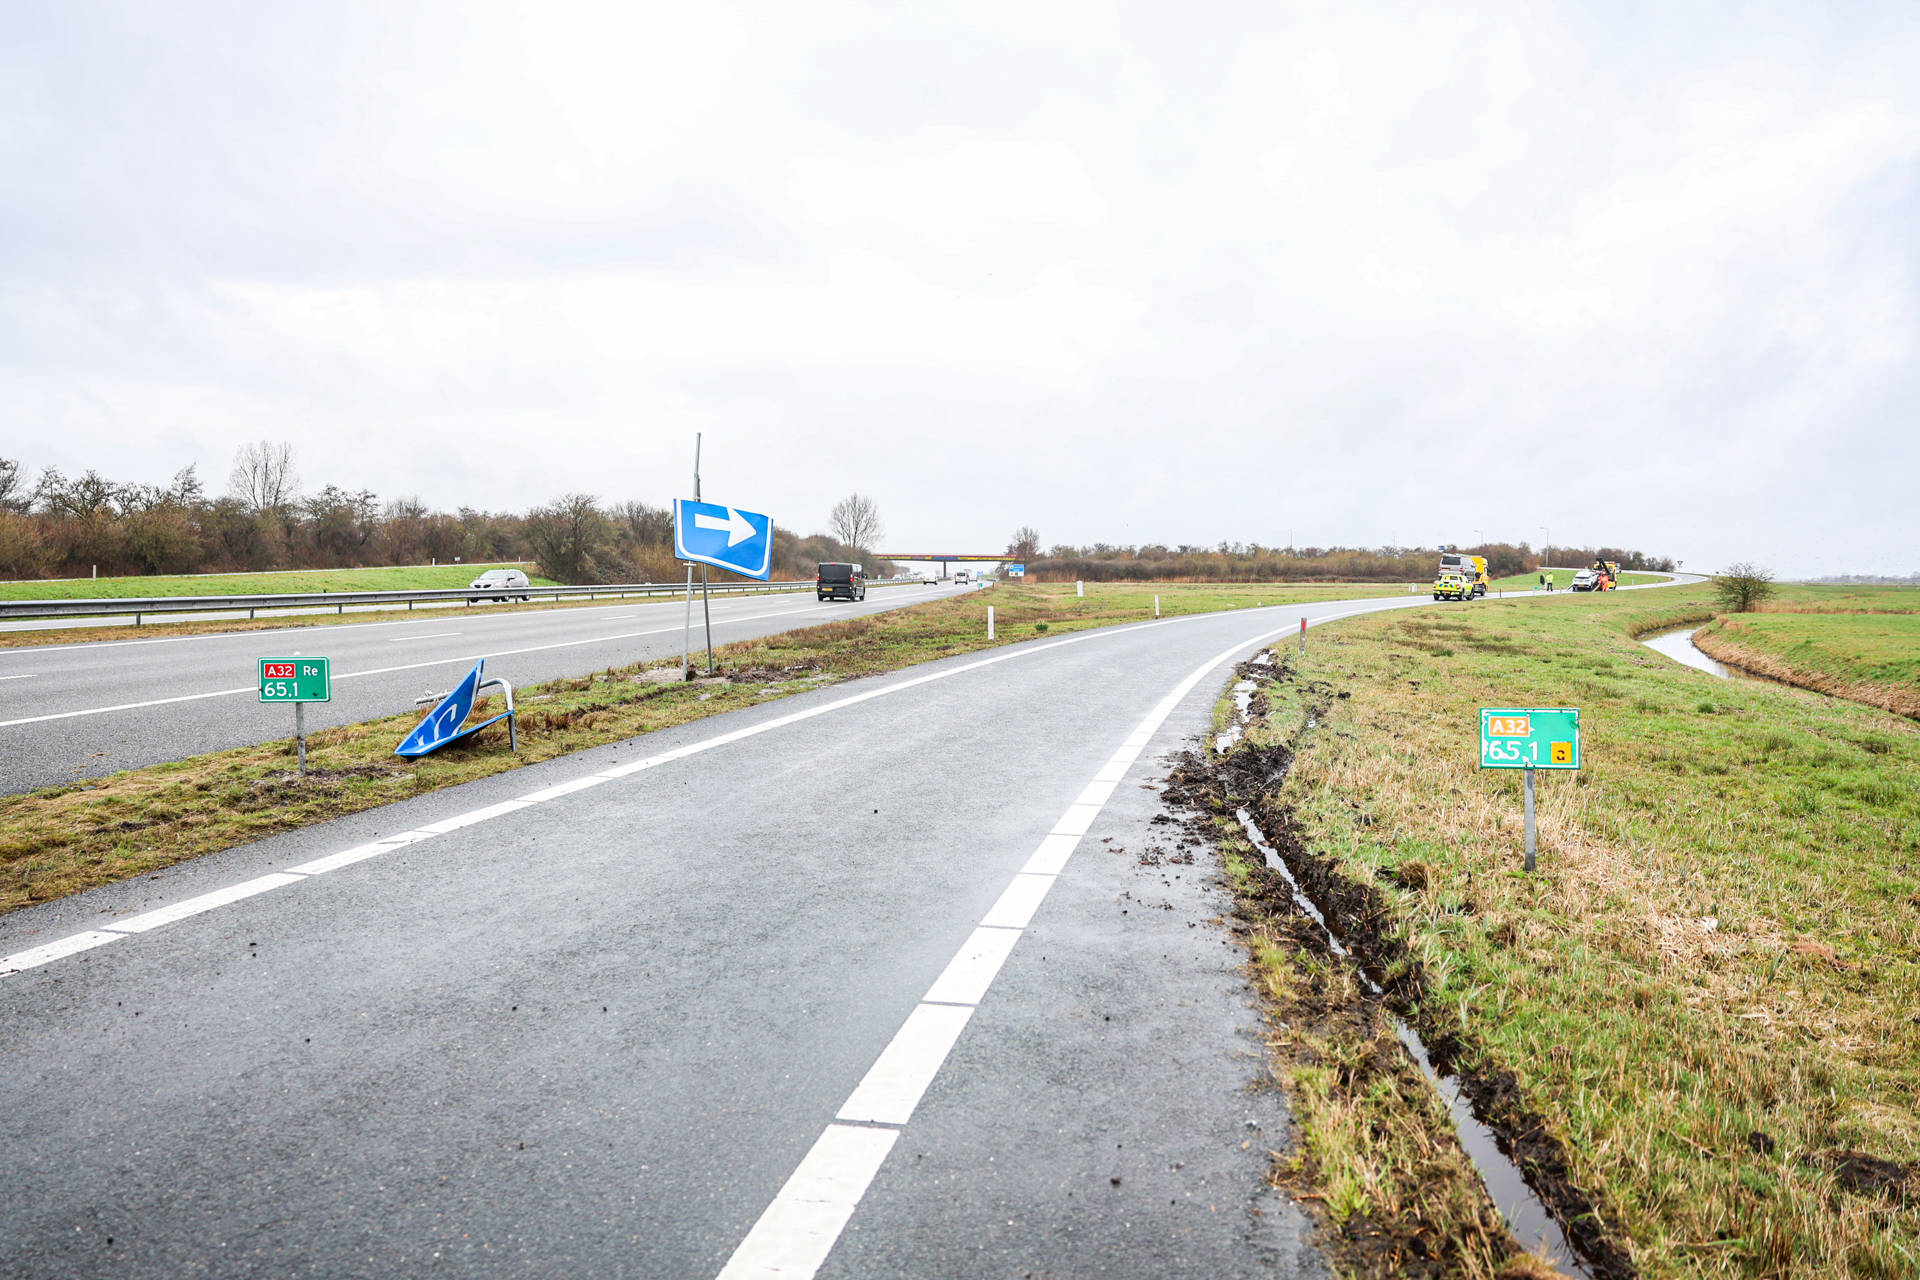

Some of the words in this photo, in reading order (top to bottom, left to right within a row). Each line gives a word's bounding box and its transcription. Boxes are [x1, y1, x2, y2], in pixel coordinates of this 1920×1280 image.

[267, 665, 293, 676] A32
[303, 665, 318, 676] Re
[264, 682, 298, 698] 65,1
[1492, 719, 1526, 734] A32
